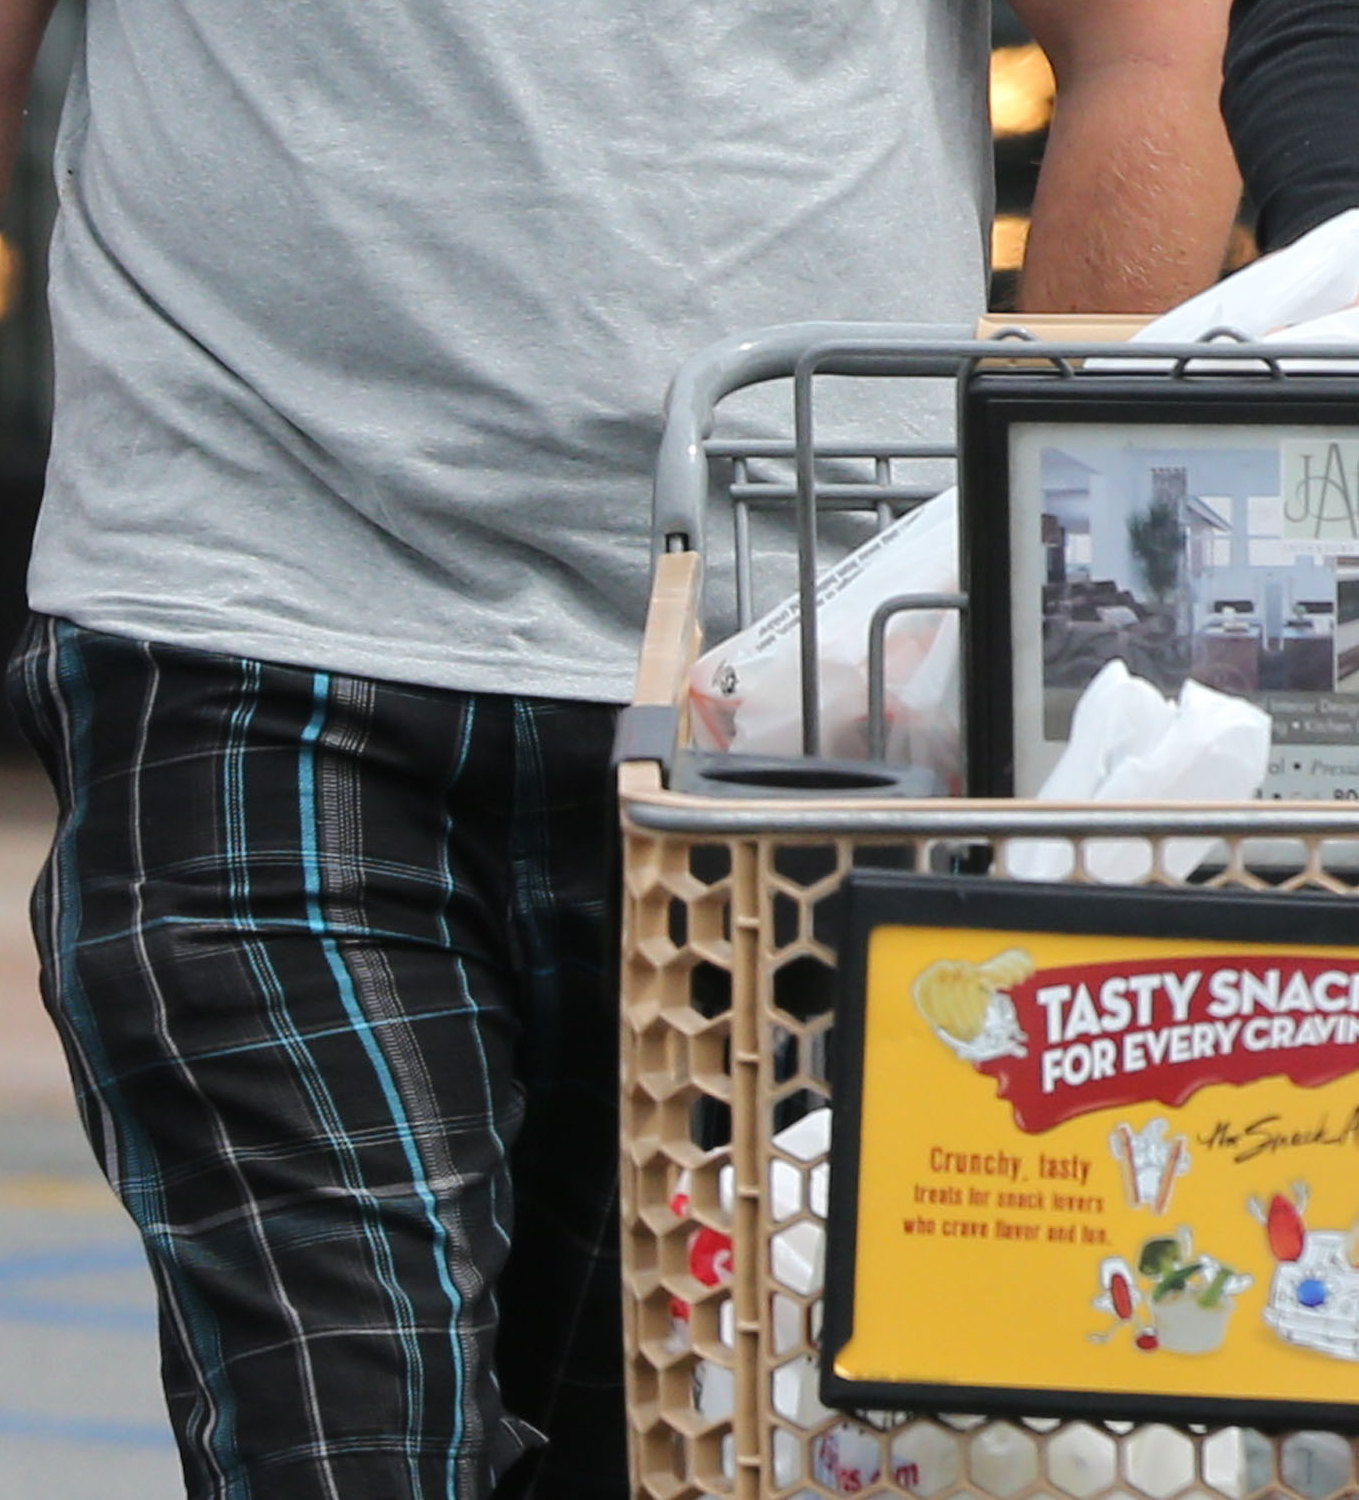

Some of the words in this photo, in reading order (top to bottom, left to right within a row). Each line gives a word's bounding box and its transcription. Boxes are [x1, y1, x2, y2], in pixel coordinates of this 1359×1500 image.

[1037, 970, 1202, 1045] TASTY
[1042, 1038, 1117, 1094] FOR
[1123, 1019, 1242, 1073] EVERY
[1039, 1154, 1092, 1186] tasty
[903, 1215, 936, 1235] who
[942, 1219, 989, 1238] crave
[1047, 1225, 1076, 1243] and
